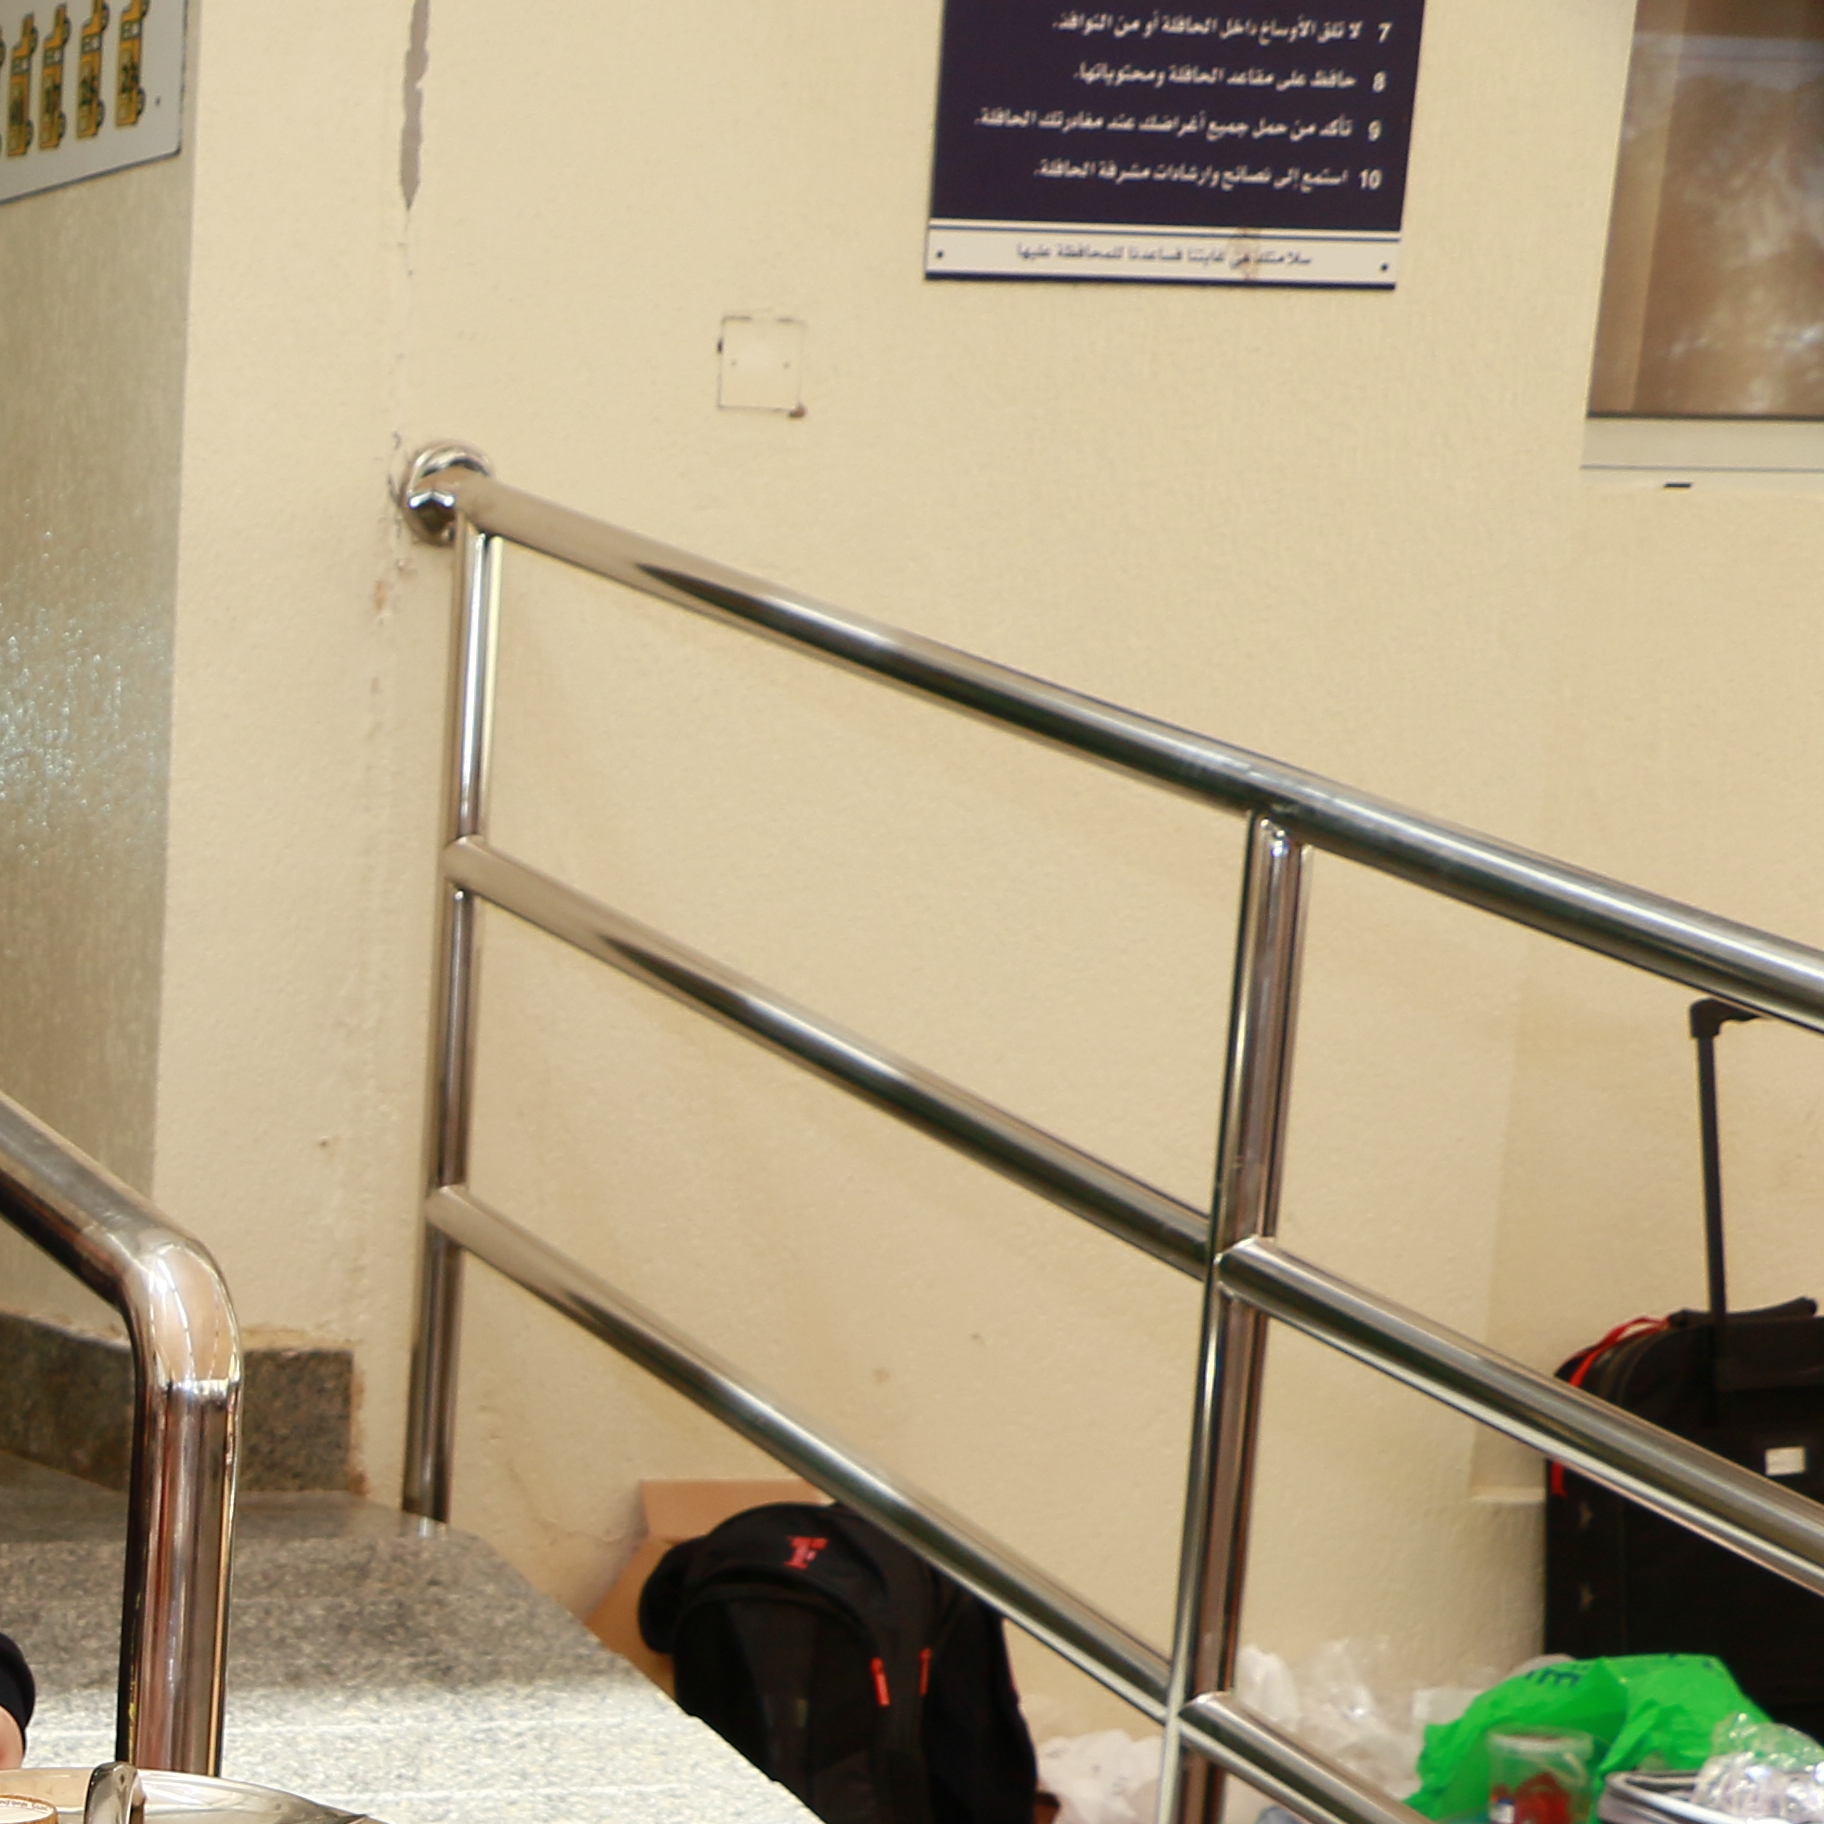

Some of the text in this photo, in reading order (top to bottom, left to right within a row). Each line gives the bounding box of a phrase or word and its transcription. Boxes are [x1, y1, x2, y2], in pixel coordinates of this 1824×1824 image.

[1113, 15, 1141, 39] من
[1161, 14, 1219, 35] الحافلة
[1348, 20, 1363, 40] لا
[1378, 21, 1393, 43] 7
[1169, 64, 1226, 85] الحافلة
[1227, 67, 1275, 86] مقاعد
[1276, 69, 1307, 92] على
[1373, 71, 1387, 93] 8
[1106, 112, 1136, 131] عند
[1206, 120, 1250, 142] جميع
[1252, 117, 1288, 139] حمل
[1289, 119, 1317, 142] من
[1368, 119, 1382, 142] 9
[1359, 168, 1382, 191] 10
